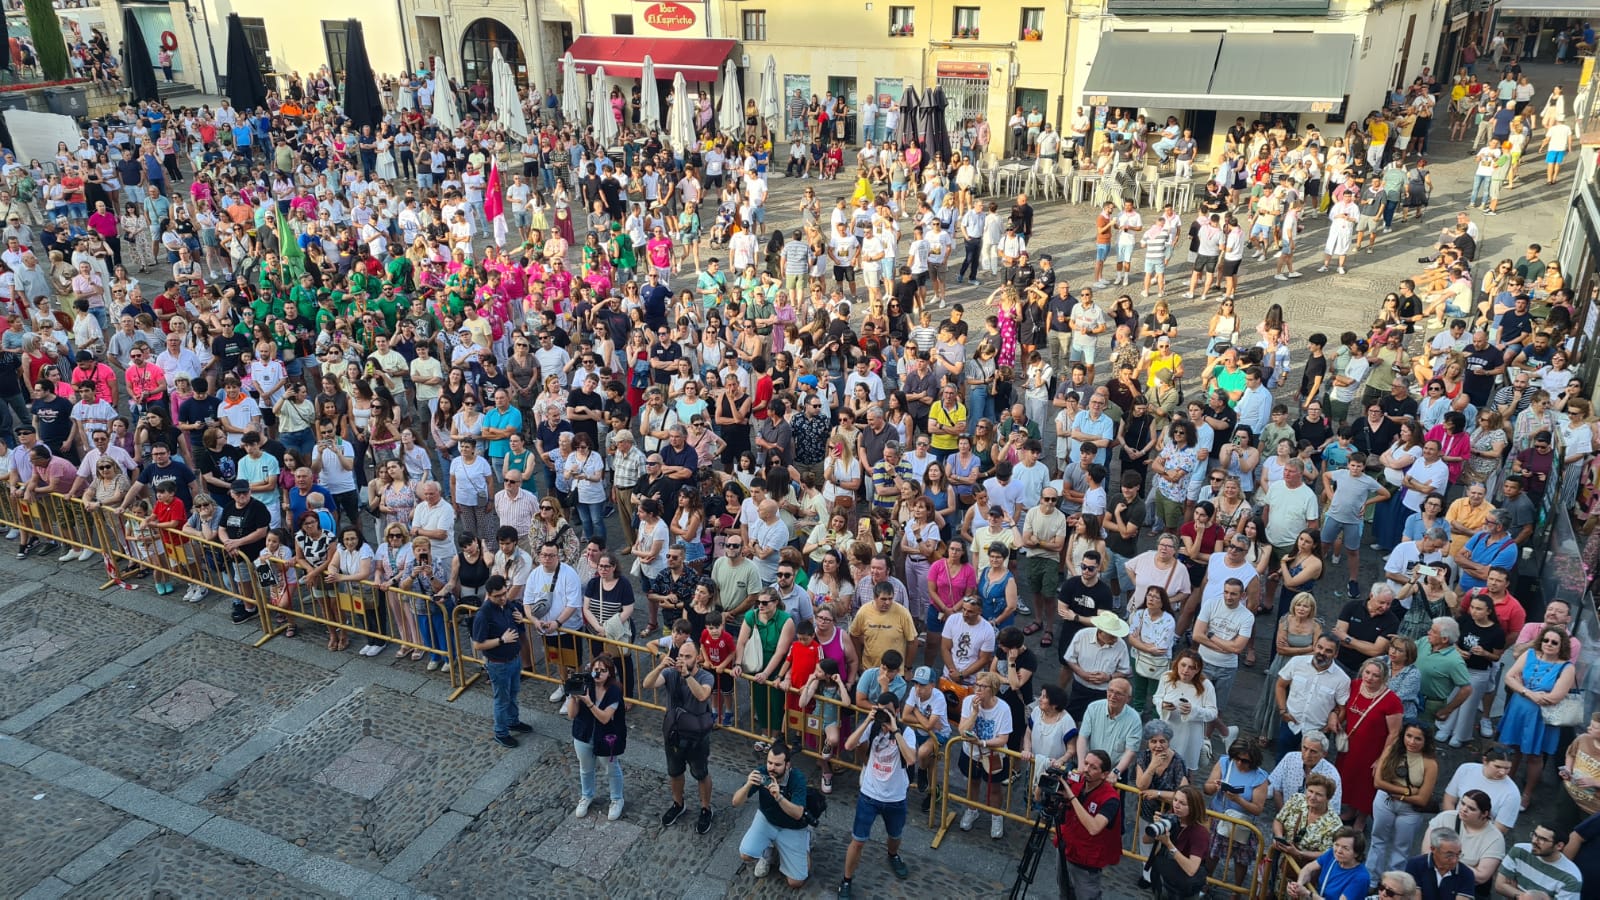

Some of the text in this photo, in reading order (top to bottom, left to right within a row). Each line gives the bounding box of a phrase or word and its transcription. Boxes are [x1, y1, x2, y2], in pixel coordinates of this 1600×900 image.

[659, 3, 677, 13] Bar
[648, 15, 693, 28] El Capricho
